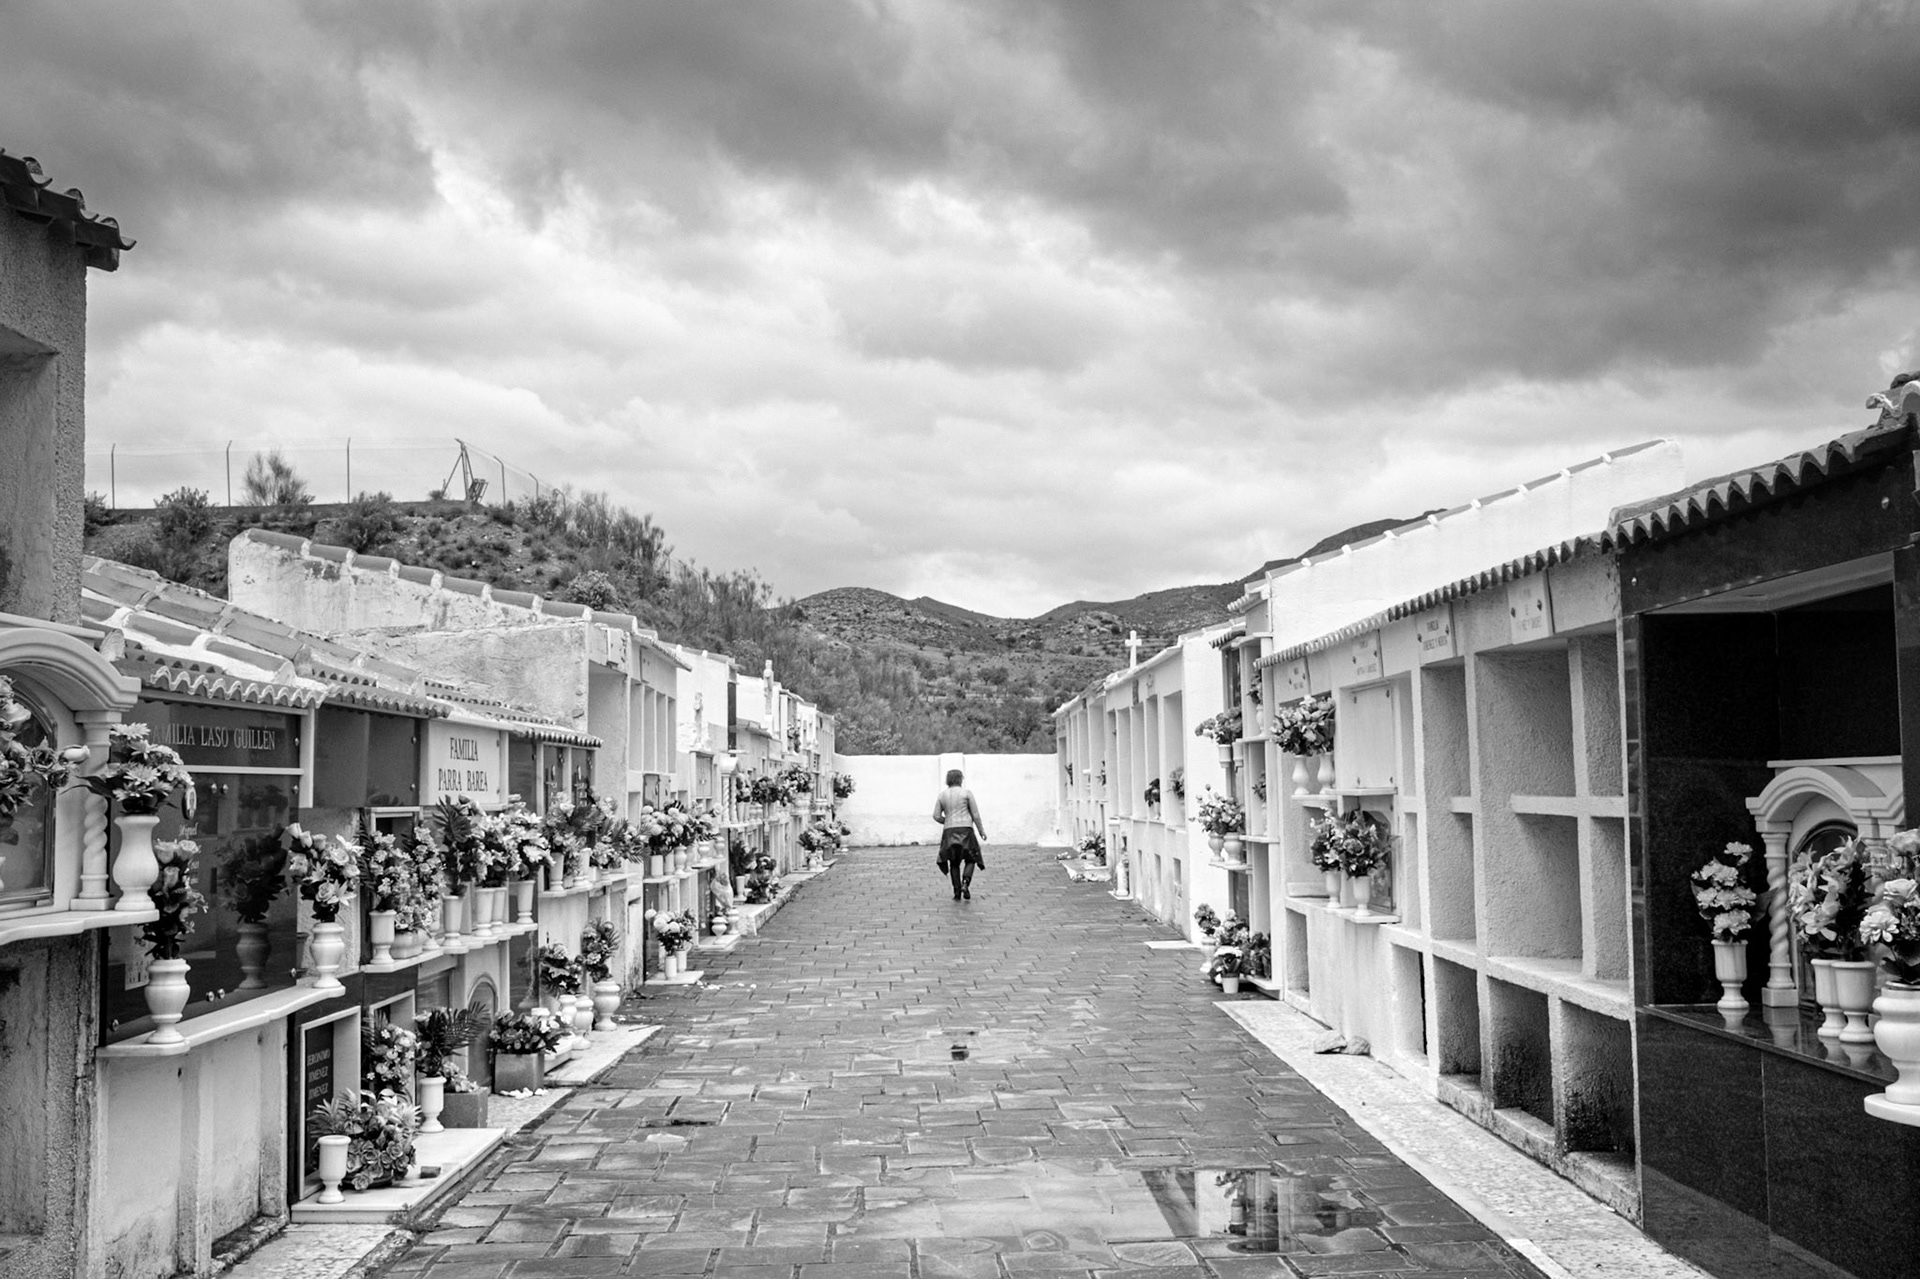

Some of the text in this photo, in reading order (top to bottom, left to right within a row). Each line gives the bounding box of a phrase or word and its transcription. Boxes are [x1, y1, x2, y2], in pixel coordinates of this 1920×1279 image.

[151, 723, 276, 750] AMILIA LASO GUILLÉN
[450, 737, 479, 761] FAMILIA
[438, 768, 488, 792] PARRA BAREA
